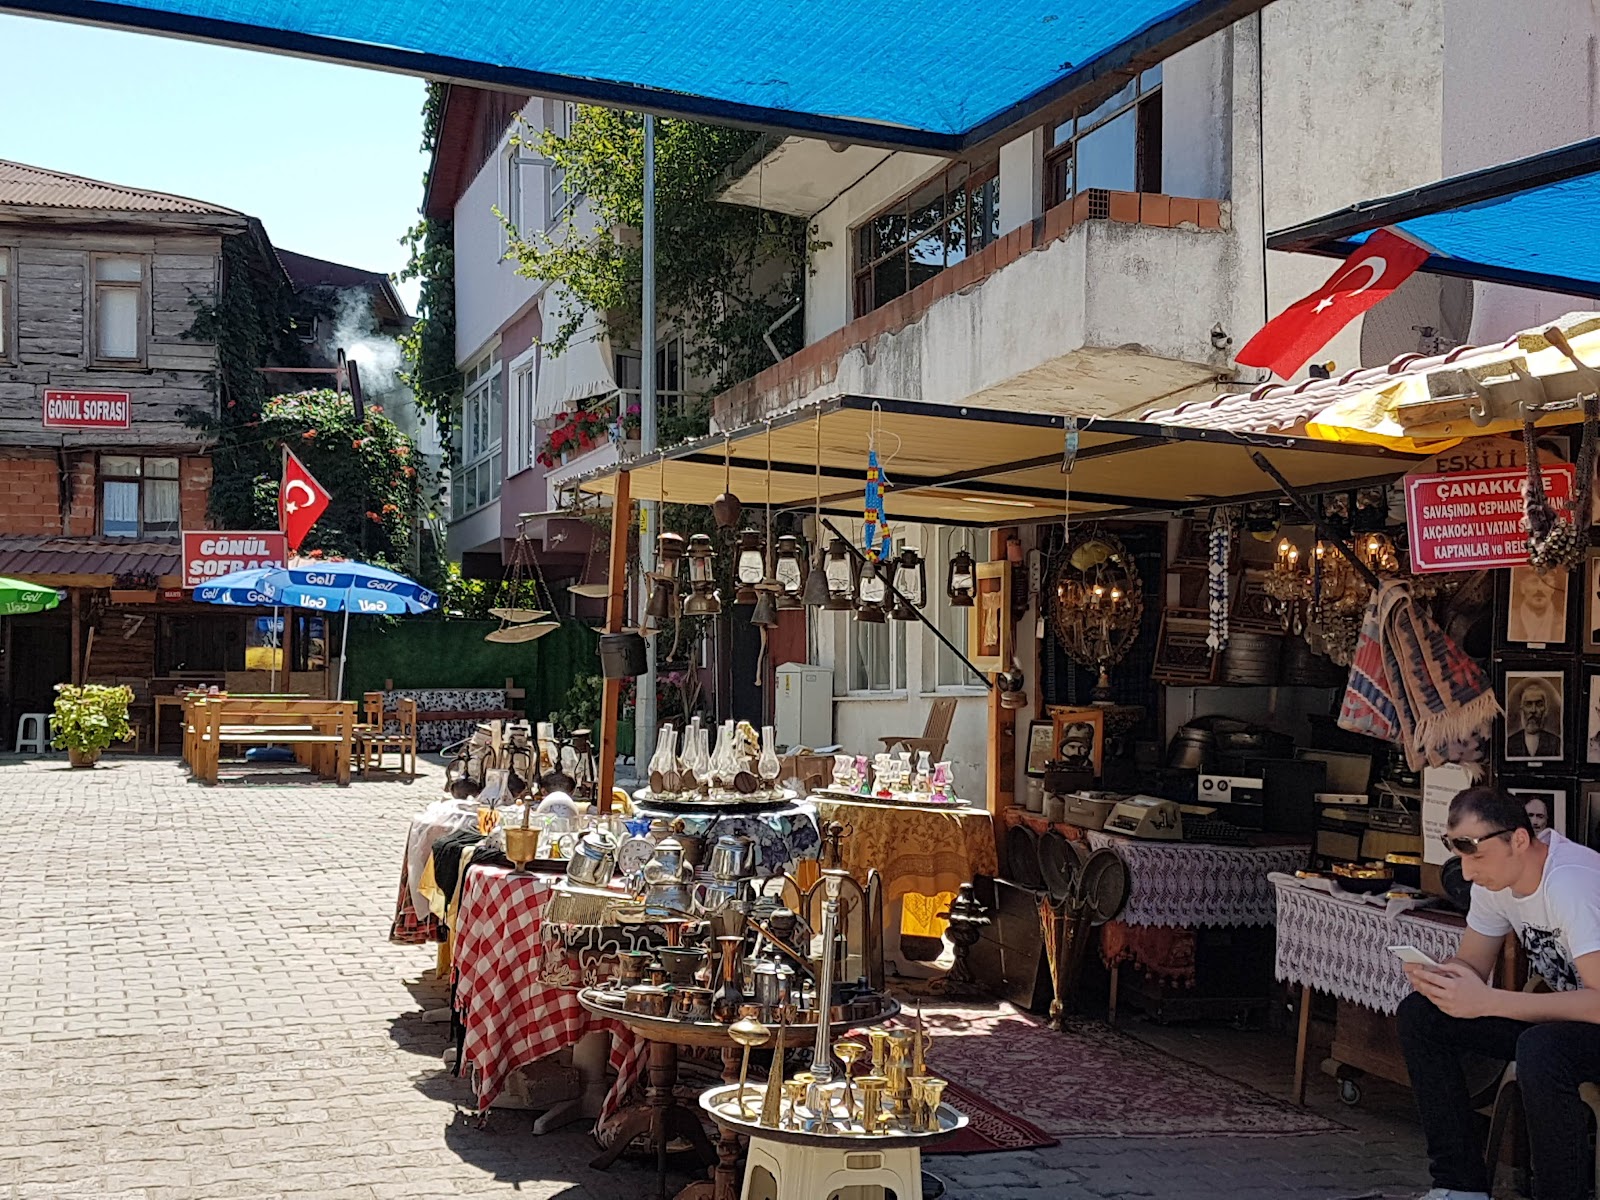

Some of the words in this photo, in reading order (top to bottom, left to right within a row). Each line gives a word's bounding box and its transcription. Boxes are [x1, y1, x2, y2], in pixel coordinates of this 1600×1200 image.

[48, 394, 82, 419] GÖNÜL
[83, 400, 126, 421] SOFRASI
[1436, 477, 1553, 501] ÇANAKKAE
[1422, 501, 1477, 521] SAVAŞINDA
[1478, 500, 1524, 516] CEPHANE
[1486, 521, 1517, 535] VATAN
[200, 536, 270, 556] GÖNÜL
[1434, 542, 1490, 560] KAPTANLAR
[1491, 545, 1503, 555] ve
[306, 572, 337, 586] Golf
[367, 579, 399, 592] Golf
[21, 591, 44, 603] Golf
[202, 588, 219, 600] Golf
